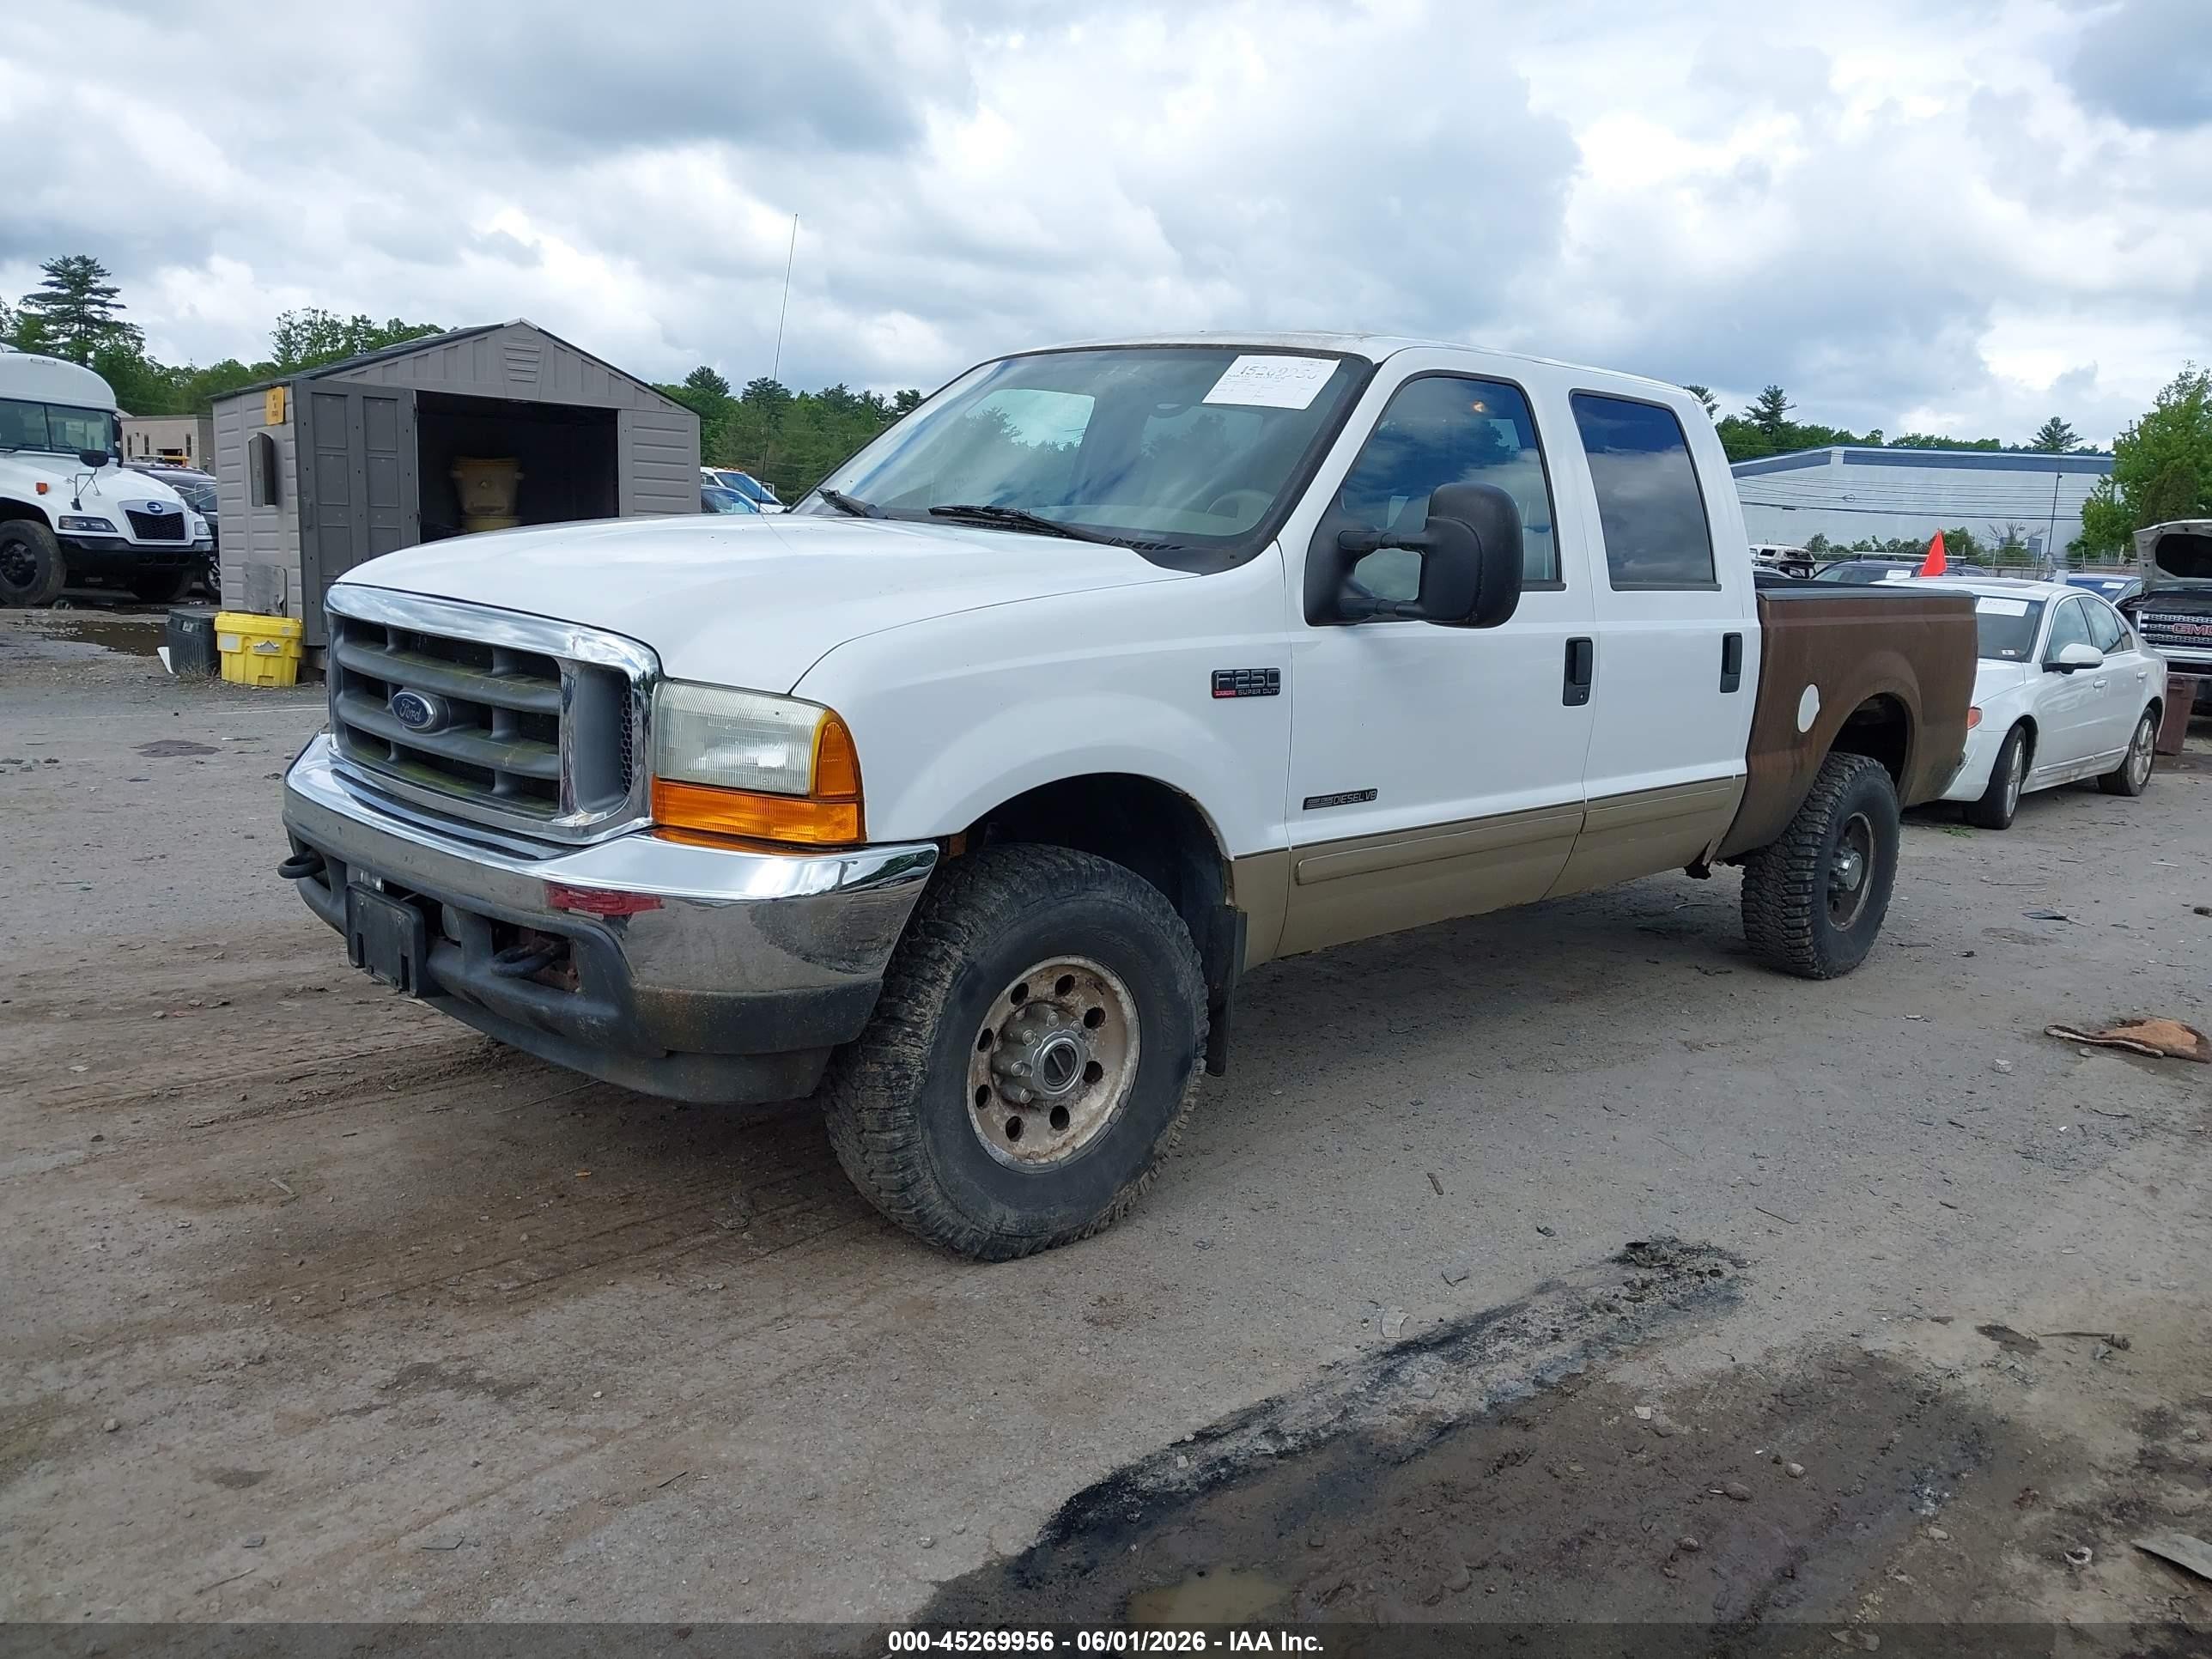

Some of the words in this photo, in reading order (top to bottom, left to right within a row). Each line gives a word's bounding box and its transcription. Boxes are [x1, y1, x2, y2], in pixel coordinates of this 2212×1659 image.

[399, 698, 422, 721] Ford
[1333, 793, 1364, 805] DIESEL
[1365, 790, 1376, 800] V8
